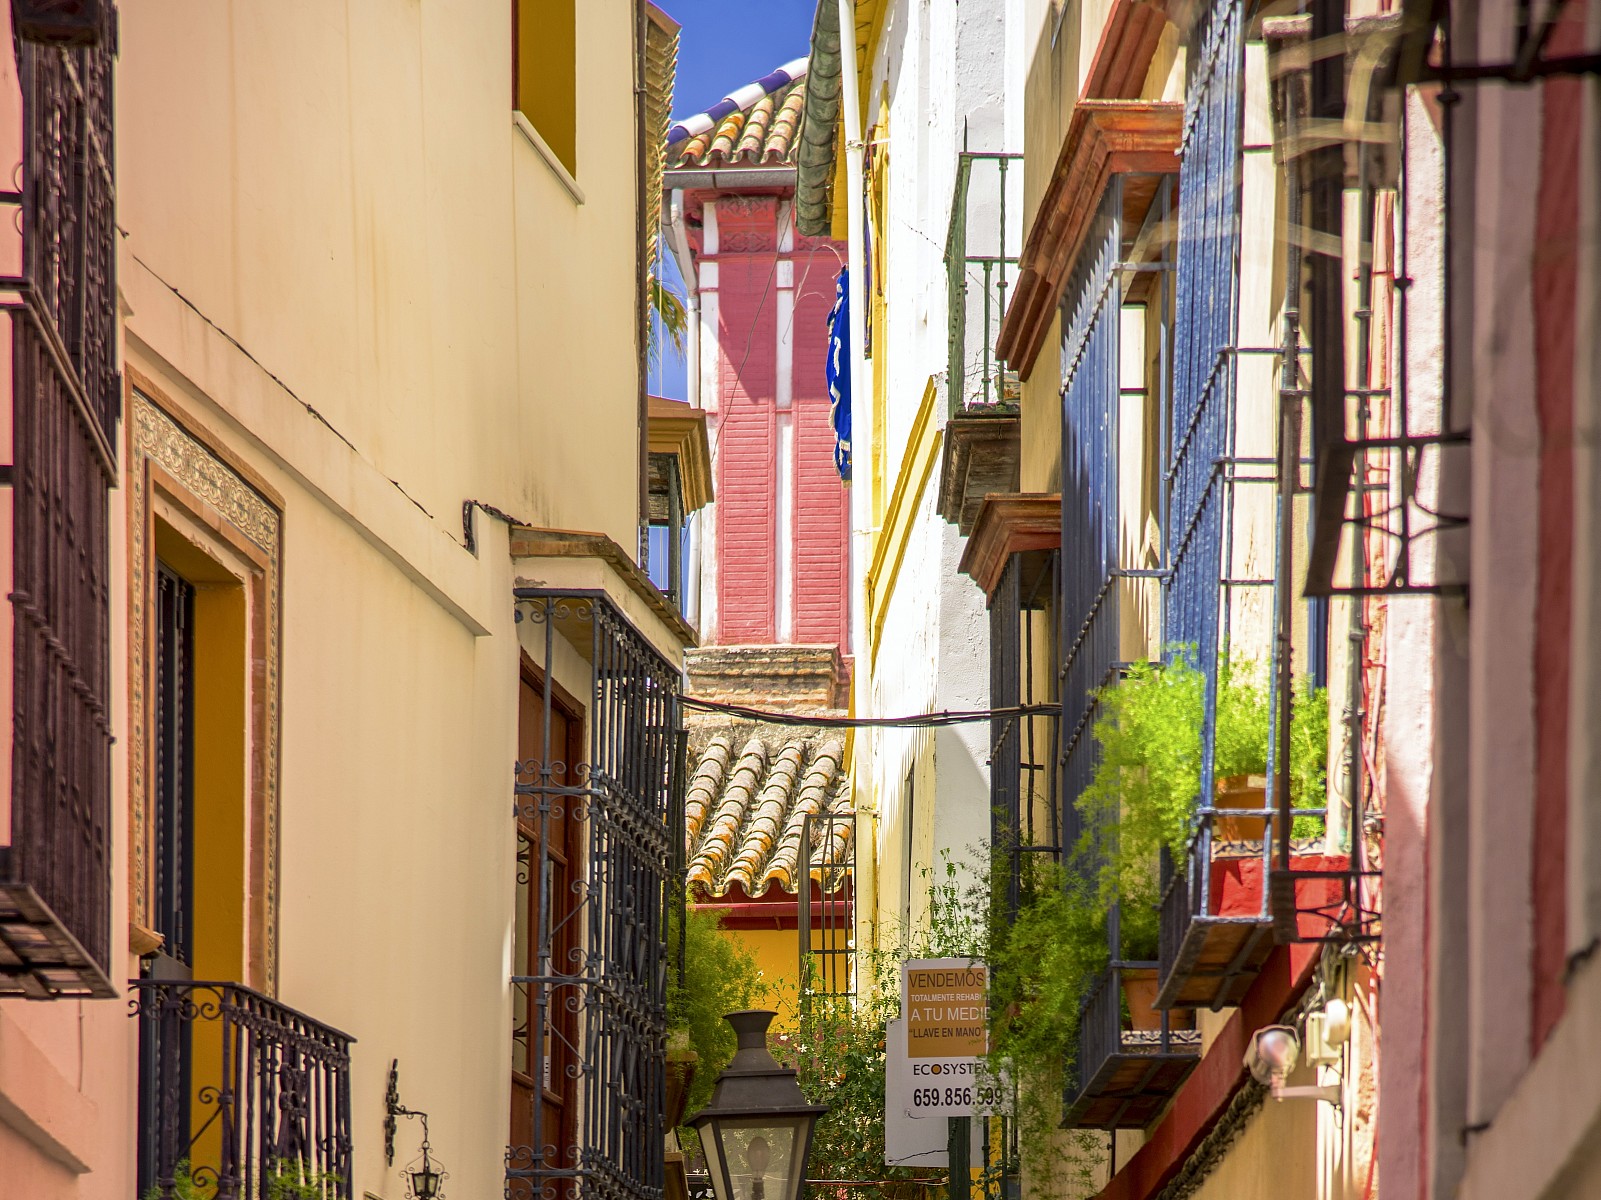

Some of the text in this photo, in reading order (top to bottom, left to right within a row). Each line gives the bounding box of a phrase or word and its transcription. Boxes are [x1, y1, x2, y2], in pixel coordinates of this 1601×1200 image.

[908, 972, 984, 988] VENDEMOS
[910, 993, 955, 1002] TOTALMENTE
[910, 1008, 921, 1022] A
[923, 1007, 943, 1021] TU
[941, 1027, 953, 1037] EN
